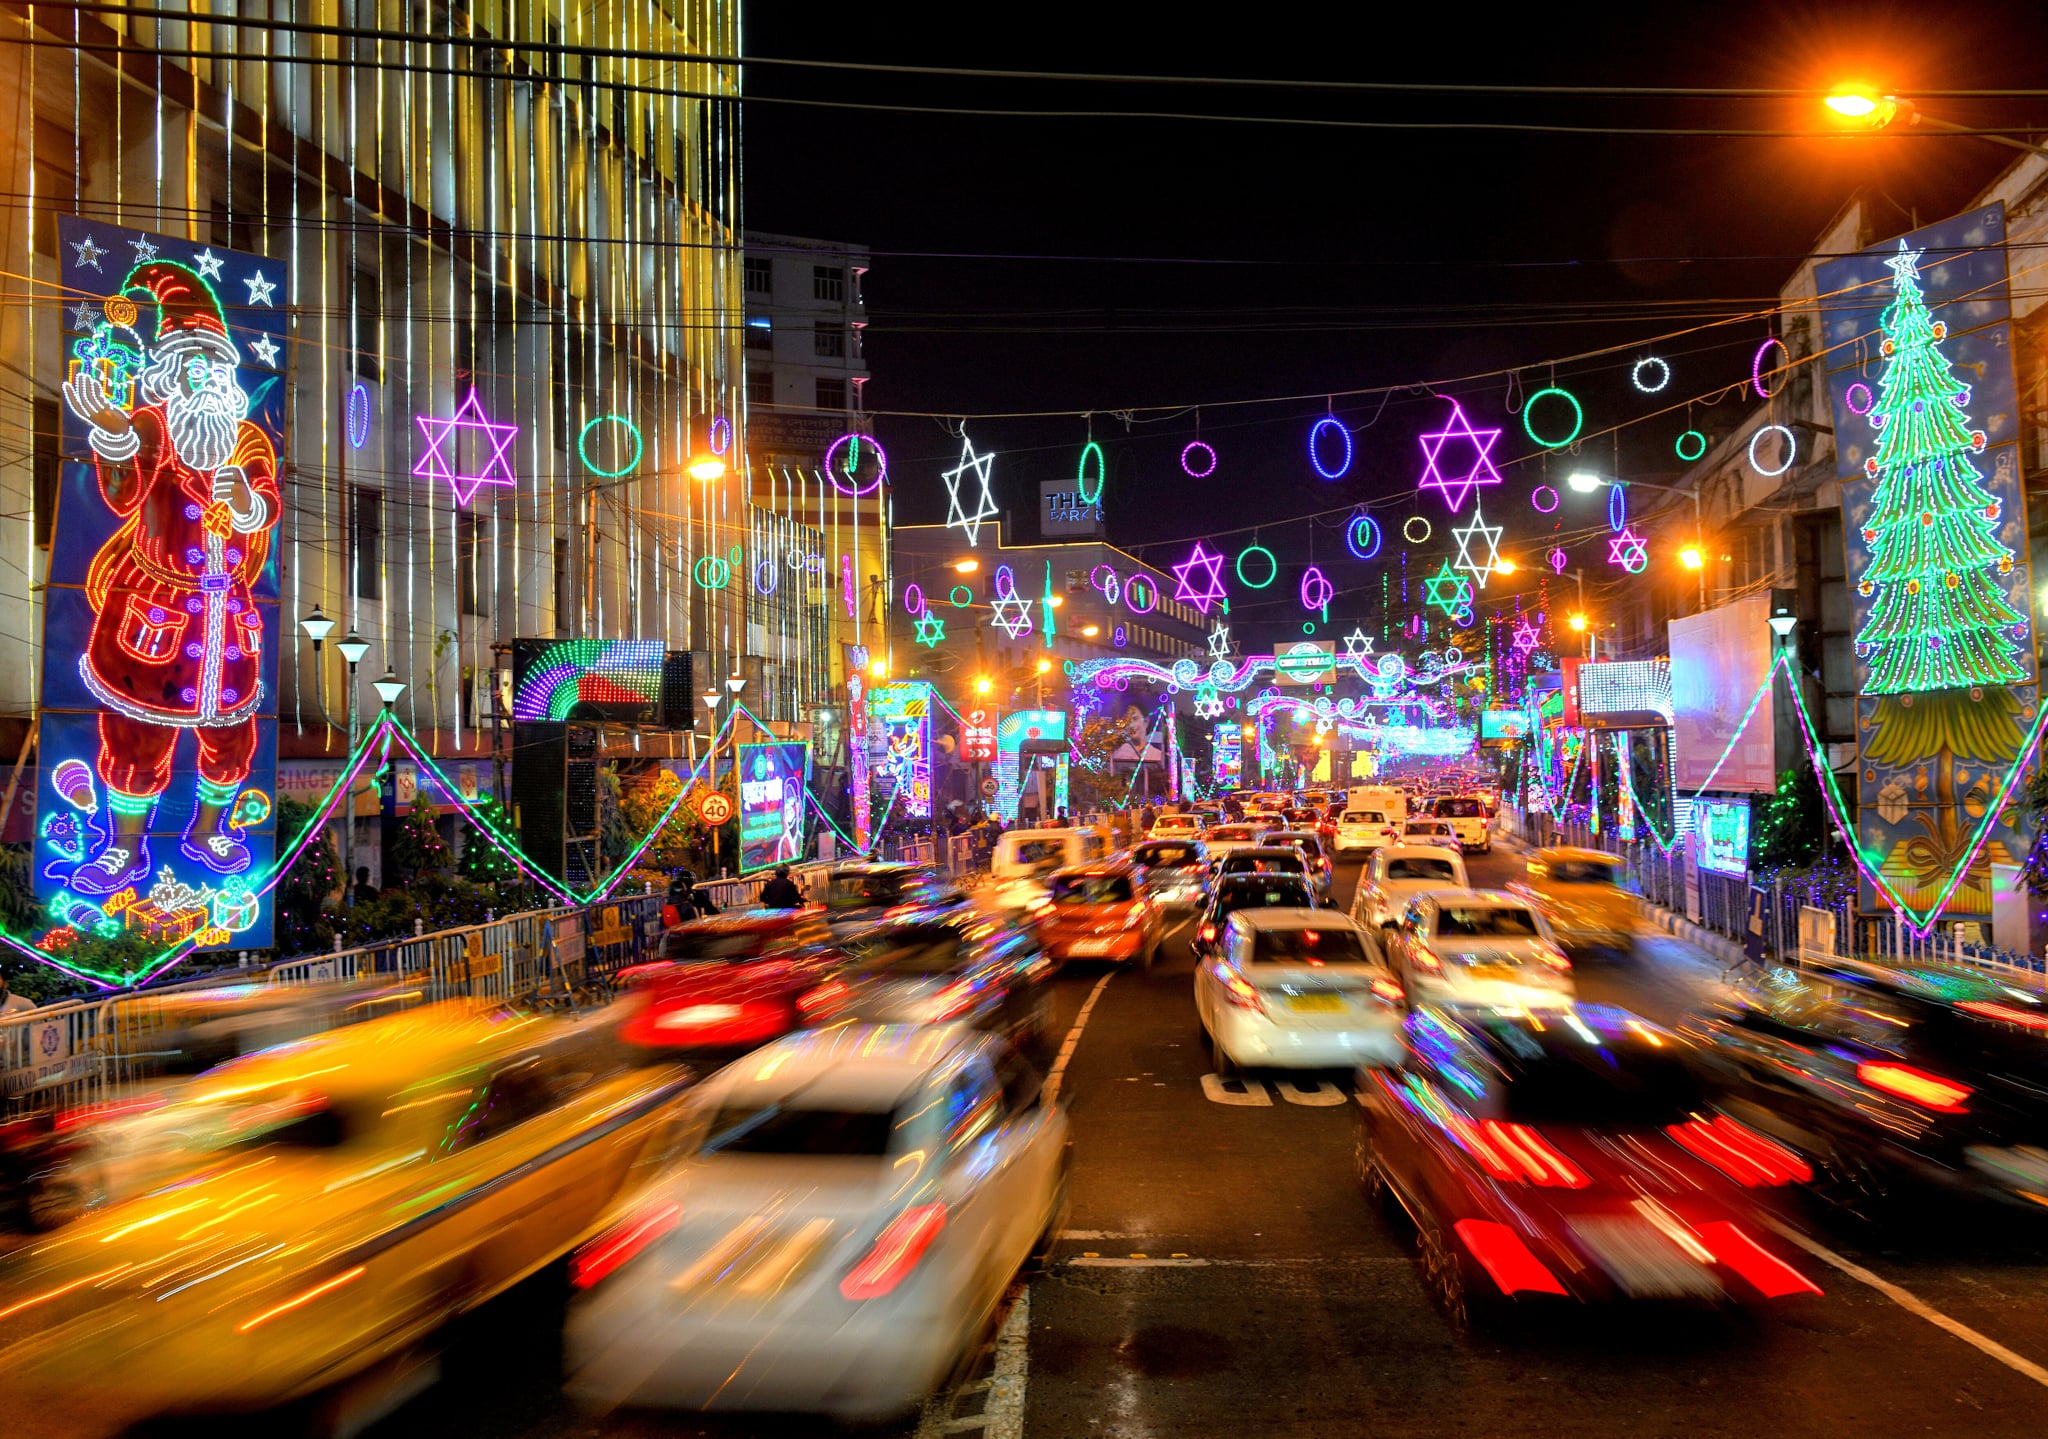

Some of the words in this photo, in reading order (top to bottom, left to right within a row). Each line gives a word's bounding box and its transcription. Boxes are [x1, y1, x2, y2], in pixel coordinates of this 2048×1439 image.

[788, 436, 836, 445] SOCIET
[1045, 492, 1090, 510] THE
[1050, 508, 1089, 521] PARK
[965, 727, 992, 737] airtel
[966, 737, 992, 745] STORE
[704, 805, 727, 817] 40
